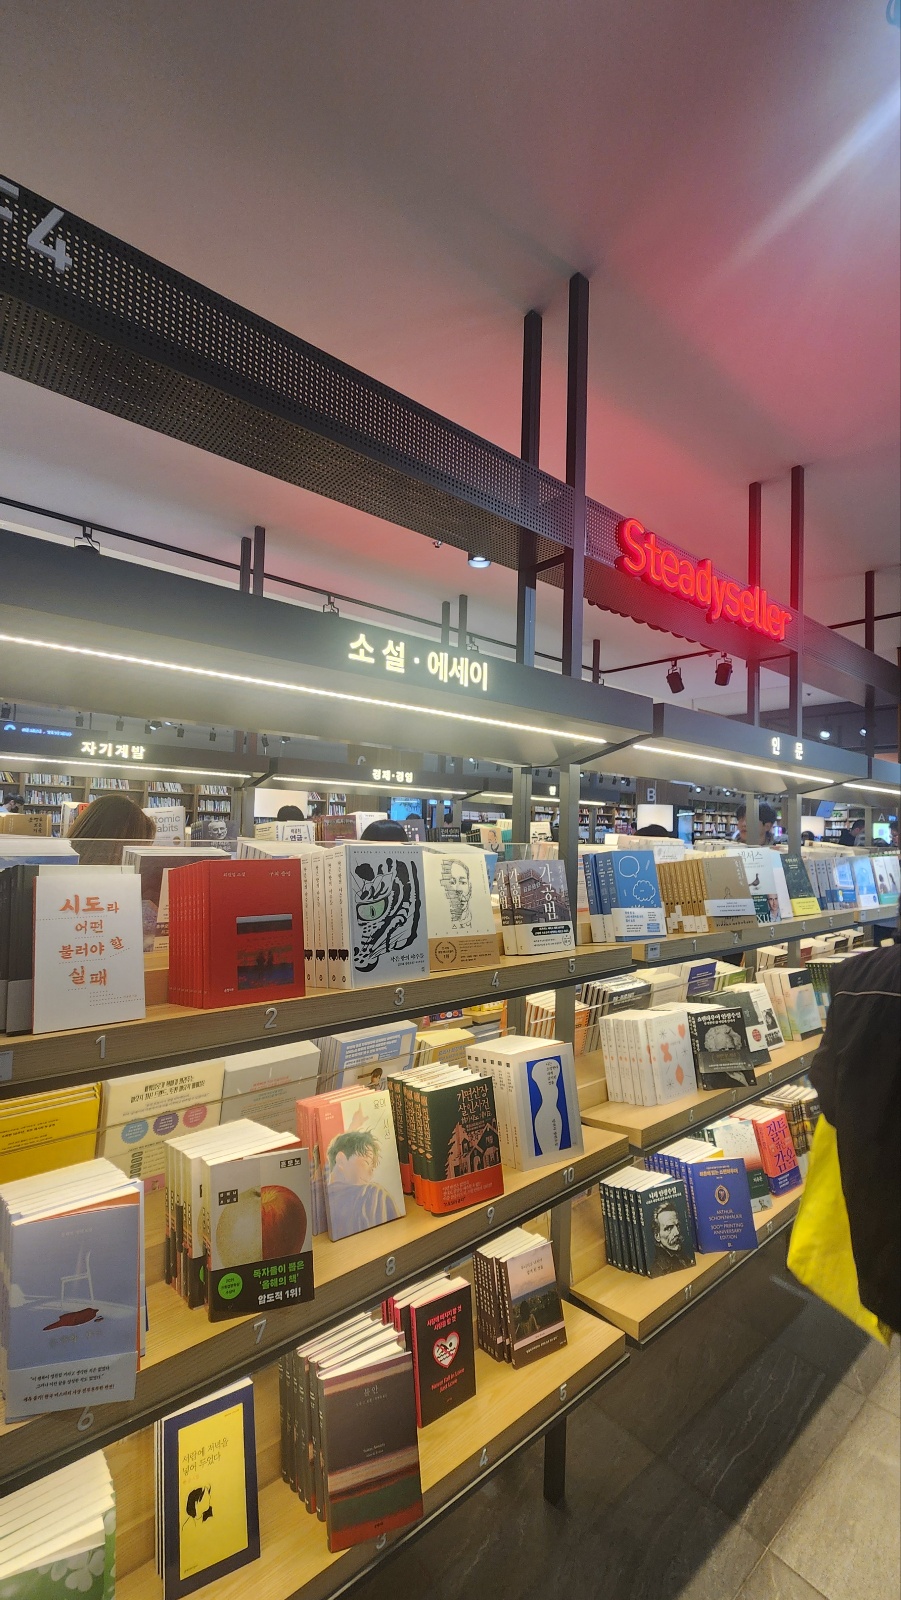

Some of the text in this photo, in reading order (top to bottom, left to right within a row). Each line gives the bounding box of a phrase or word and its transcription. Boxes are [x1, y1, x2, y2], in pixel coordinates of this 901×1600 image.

[618, 518, 793, 643] Steadyseller
[81, 741, 146, 760] 자기계발
[647, 788, 656, 802] B
[153, 814, 182, 824] tomic
[878, 813, 886, 822] A
[156, 824, 179, 833] abits
[539, 863, 557, 921] 가공범
[59, 895, 120, 914] 시도라
[75, 920, 104, 934] 어떤
[828, 917, 833, 927] 5
[733, 932, 739, 944] 2
[770, 927, 775, 937] 3
[59, 936, 124, 960] 불러야 할
[692, 939, 697, 952] 1
[567, 958, 576, 973] 5
[69, 966, 108, 986] 실패
[491, 971, 500, 987] 4
[394, 987, 405, 1006] 3
[265, 1007, 278, 1029] 2
[95, 1035, 107, 1059] 1
[768, 1073, 773, 1083] 8
[457, 1084, 488, 1103] 가면산장
[731, 1090, 737, 1101] 7
[458, 1097, 490, 1117] 살인사건
[562, 1167, 575, 1184] 10
[487, 1206, 495, 1220] 9
[253, 1260, 305, 1279] 독자들이 뽑은
[385, 1256, 397, 1276] 8
[257, 1286, 302, 1306] 압도적 1위!
[684, 1285, 692, 1300] 11
[253, 1319, 267, 1344] 7
[559, 1383, 568, 1401] 5
[76, 1405, 94, 1432] 6
[182, 1437, 229, 1463] 서랍에 저녁을
[479, 1447, 489, 1468] 4
[182, 1451, 221, 1476] 넣어 두었다
